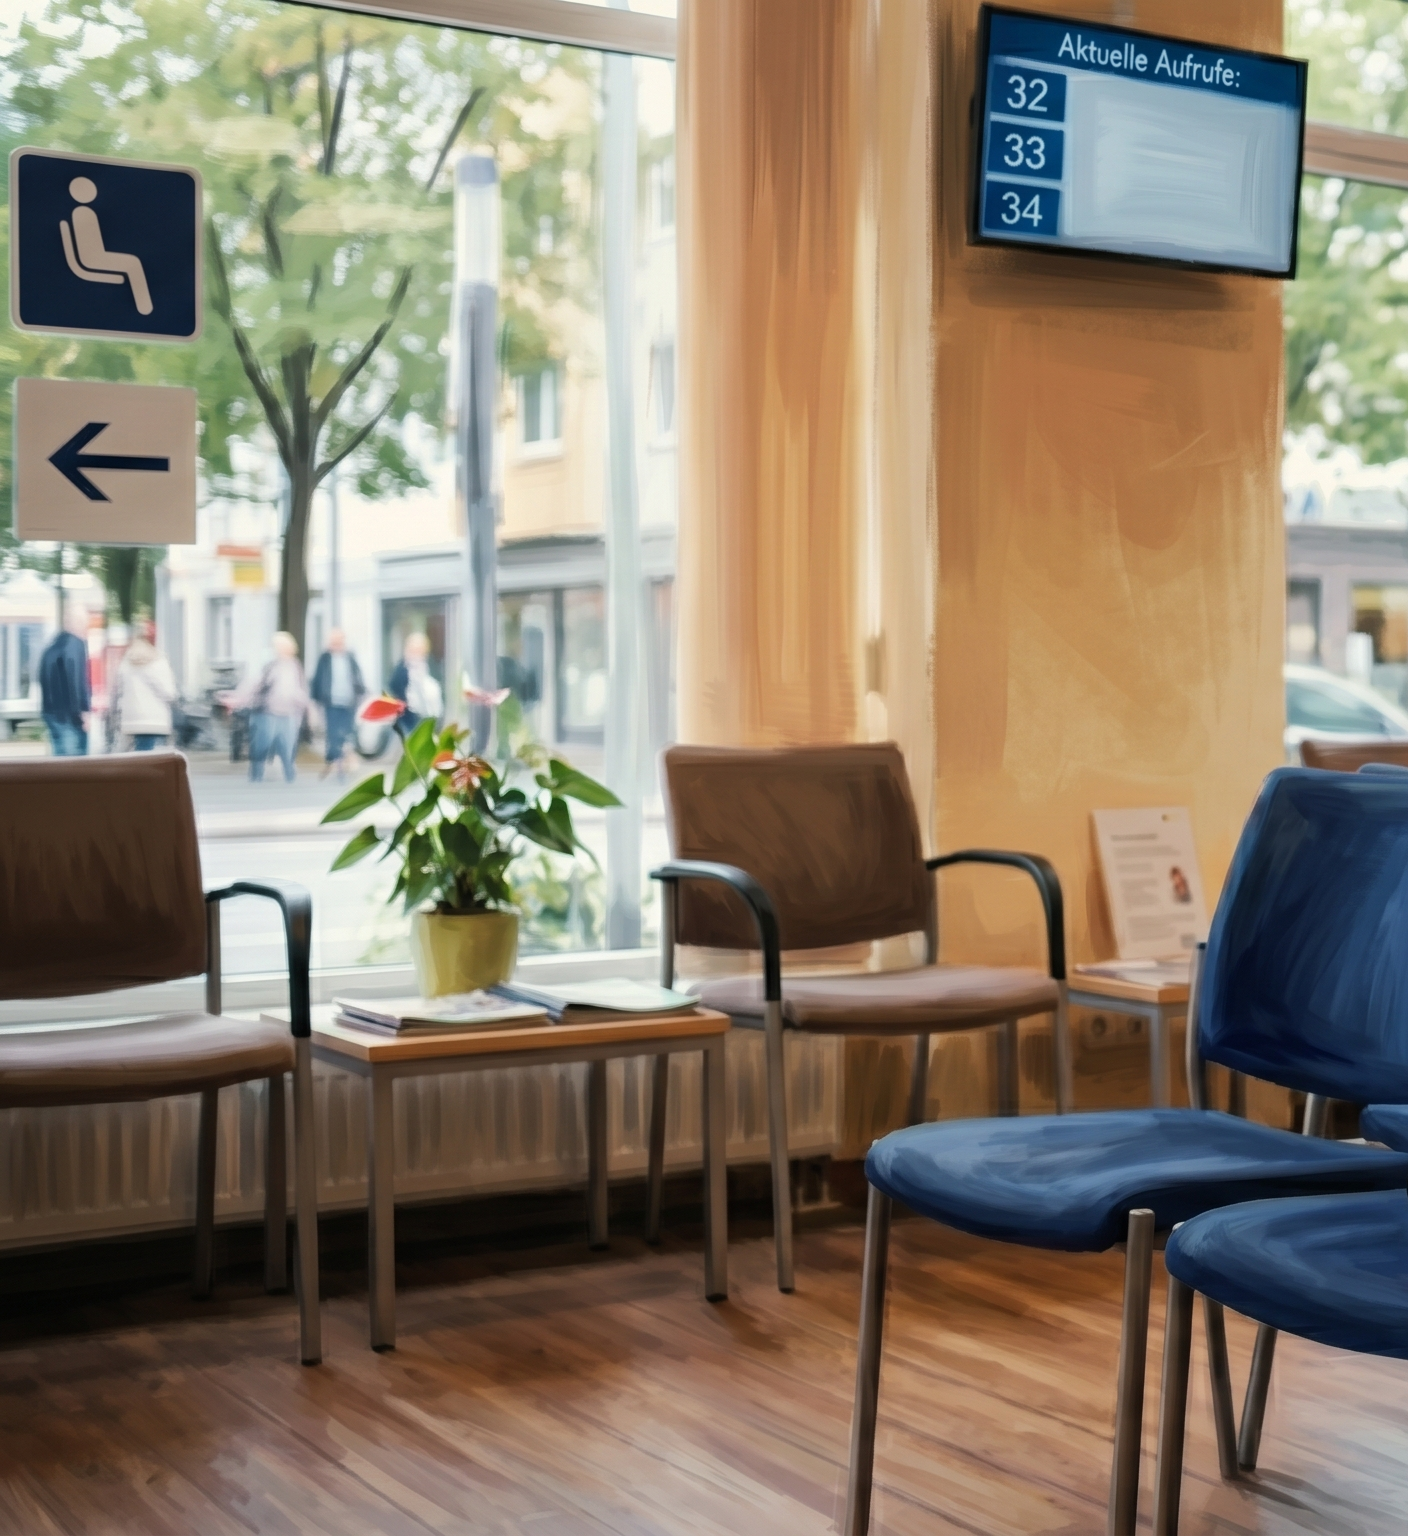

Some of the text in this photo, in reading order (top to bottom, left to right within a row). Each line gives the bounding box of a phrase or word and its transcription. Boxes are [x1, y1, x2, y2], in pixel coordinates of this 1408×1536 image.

[1058, 32, 1241, 88] Aktuelle Aufrufe:
[1006, 74, 1049, 113] 32
[1003, 133, 1046, 170] 33
[1000, 191, 1043, 228] 34
